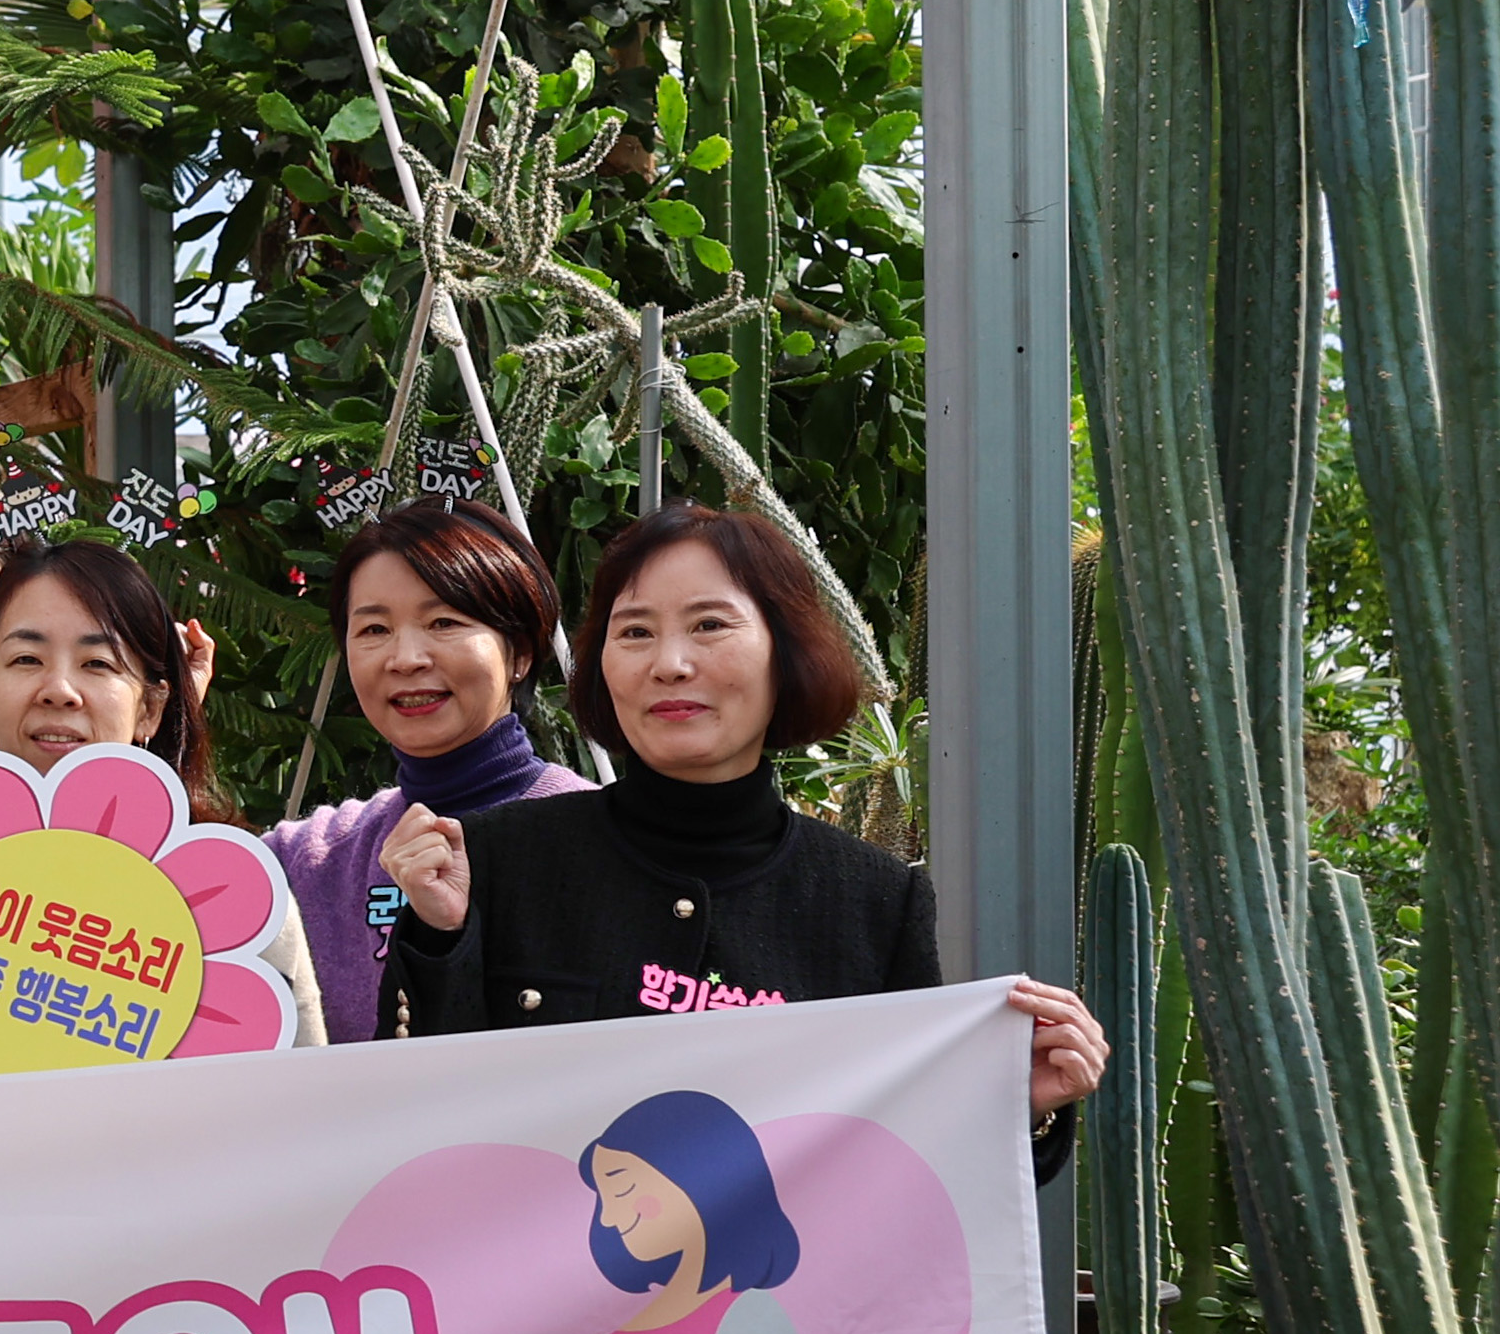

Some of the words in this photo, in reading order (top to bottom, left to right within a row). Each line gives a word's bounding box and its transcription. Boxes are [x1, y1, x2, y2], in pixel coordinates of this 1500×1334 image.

[417, 437, 470, 469] 진도
[122, 468, 174, 518] 진도
[317, 470, 394, 528] HAPPY
[421, 469, 482, 499] DAY
[107, 501, 169, 549] DAY
[30, 902, 184, 994] 웃음소리
[9, 967, 161, 1060] 행복소리
